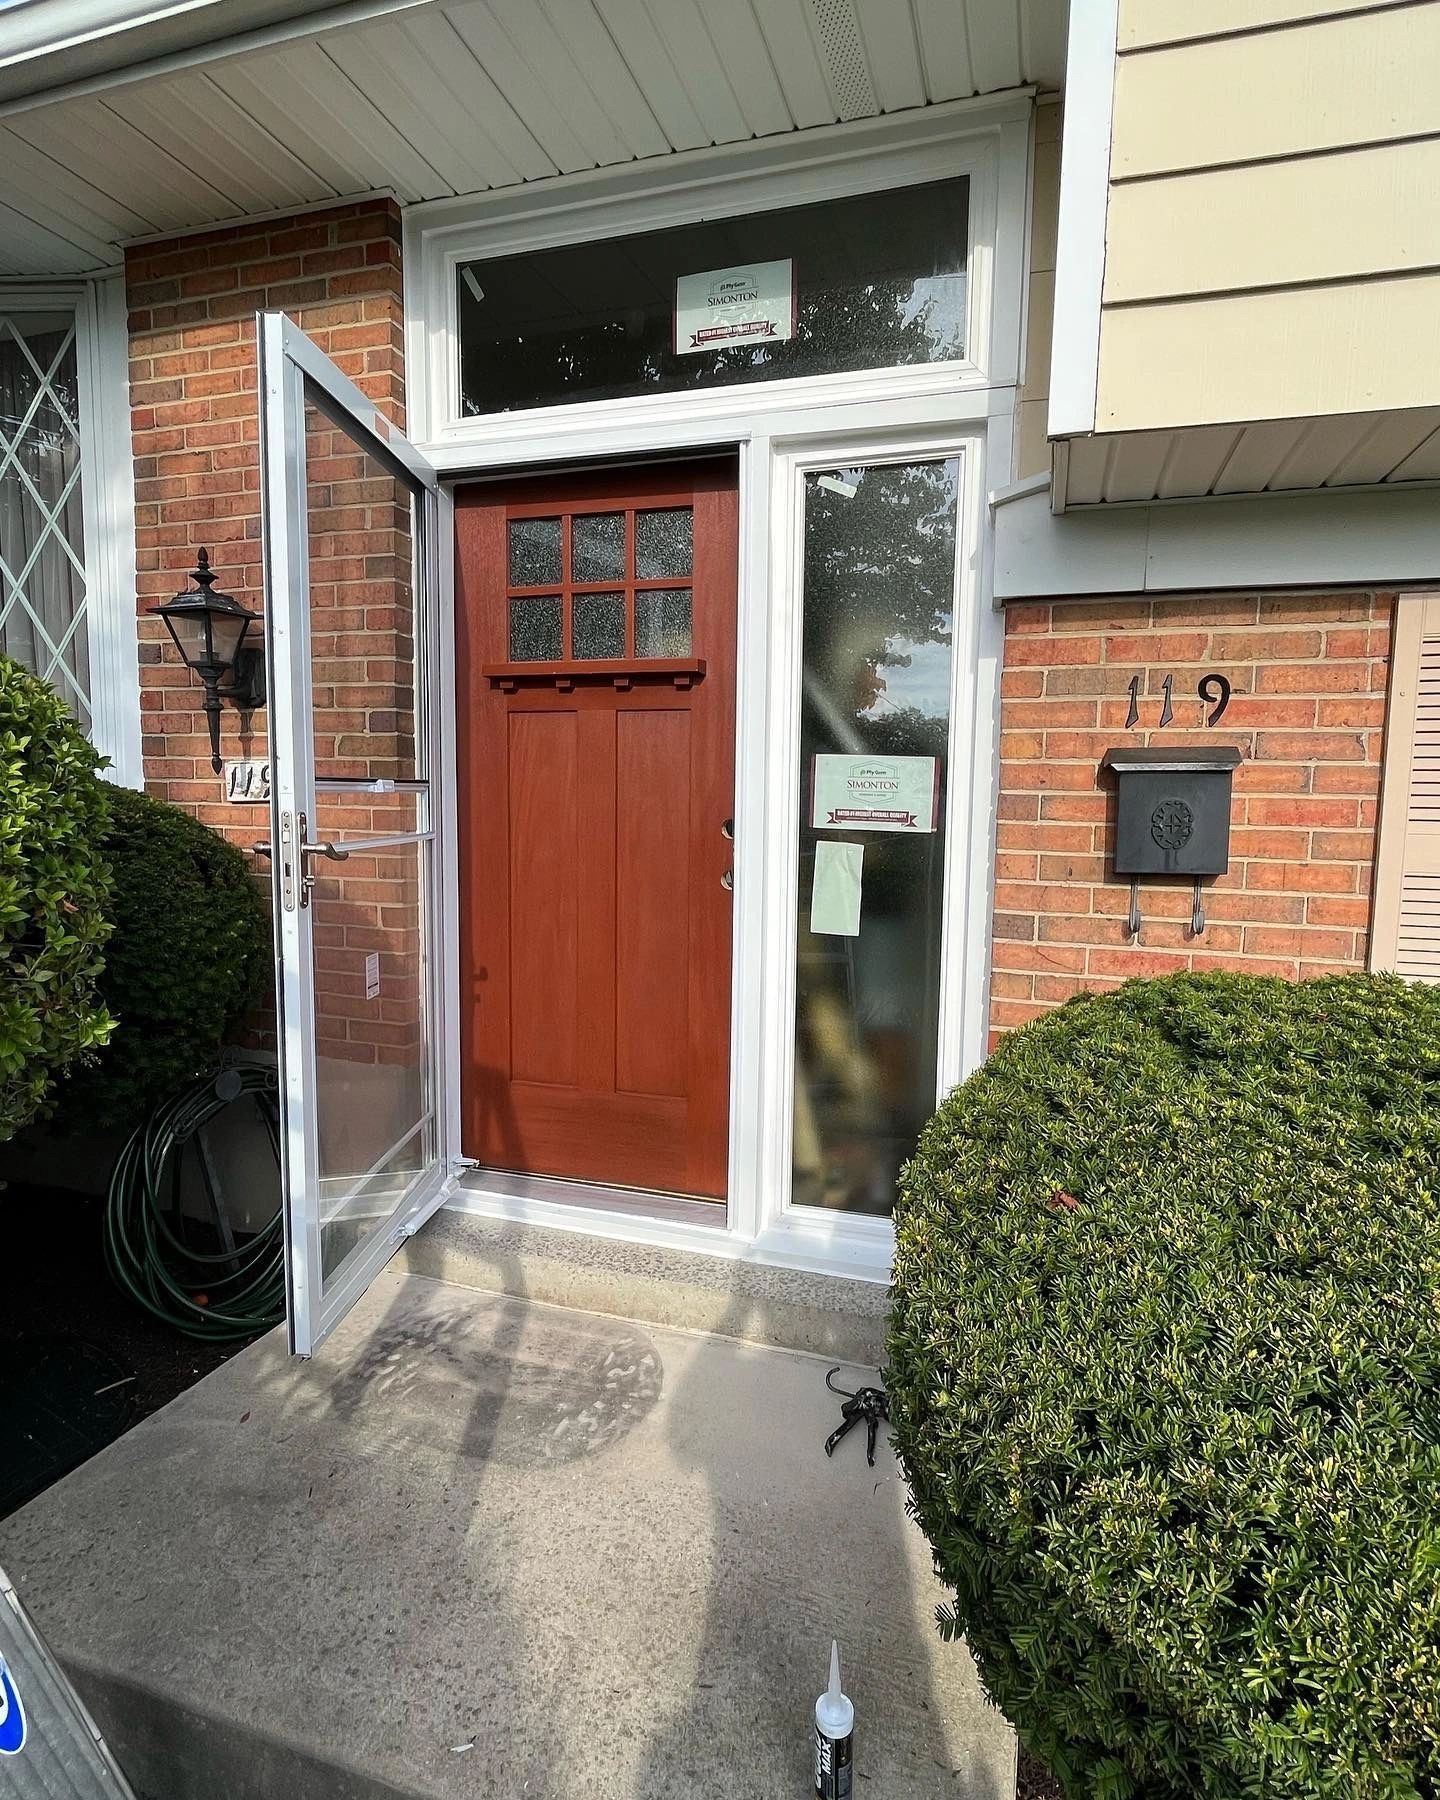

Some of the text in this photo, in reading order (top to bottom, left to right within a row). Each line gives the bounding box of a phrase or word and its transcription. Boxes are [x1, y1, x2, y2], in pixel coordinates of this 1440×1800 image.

[707, 291, 758, 307] SIMONTON
[1125, 674, 1231, 728] 119
[847, 780, 899, 790] SIMONTON
[821, 1738, 832, 1775] MAX
